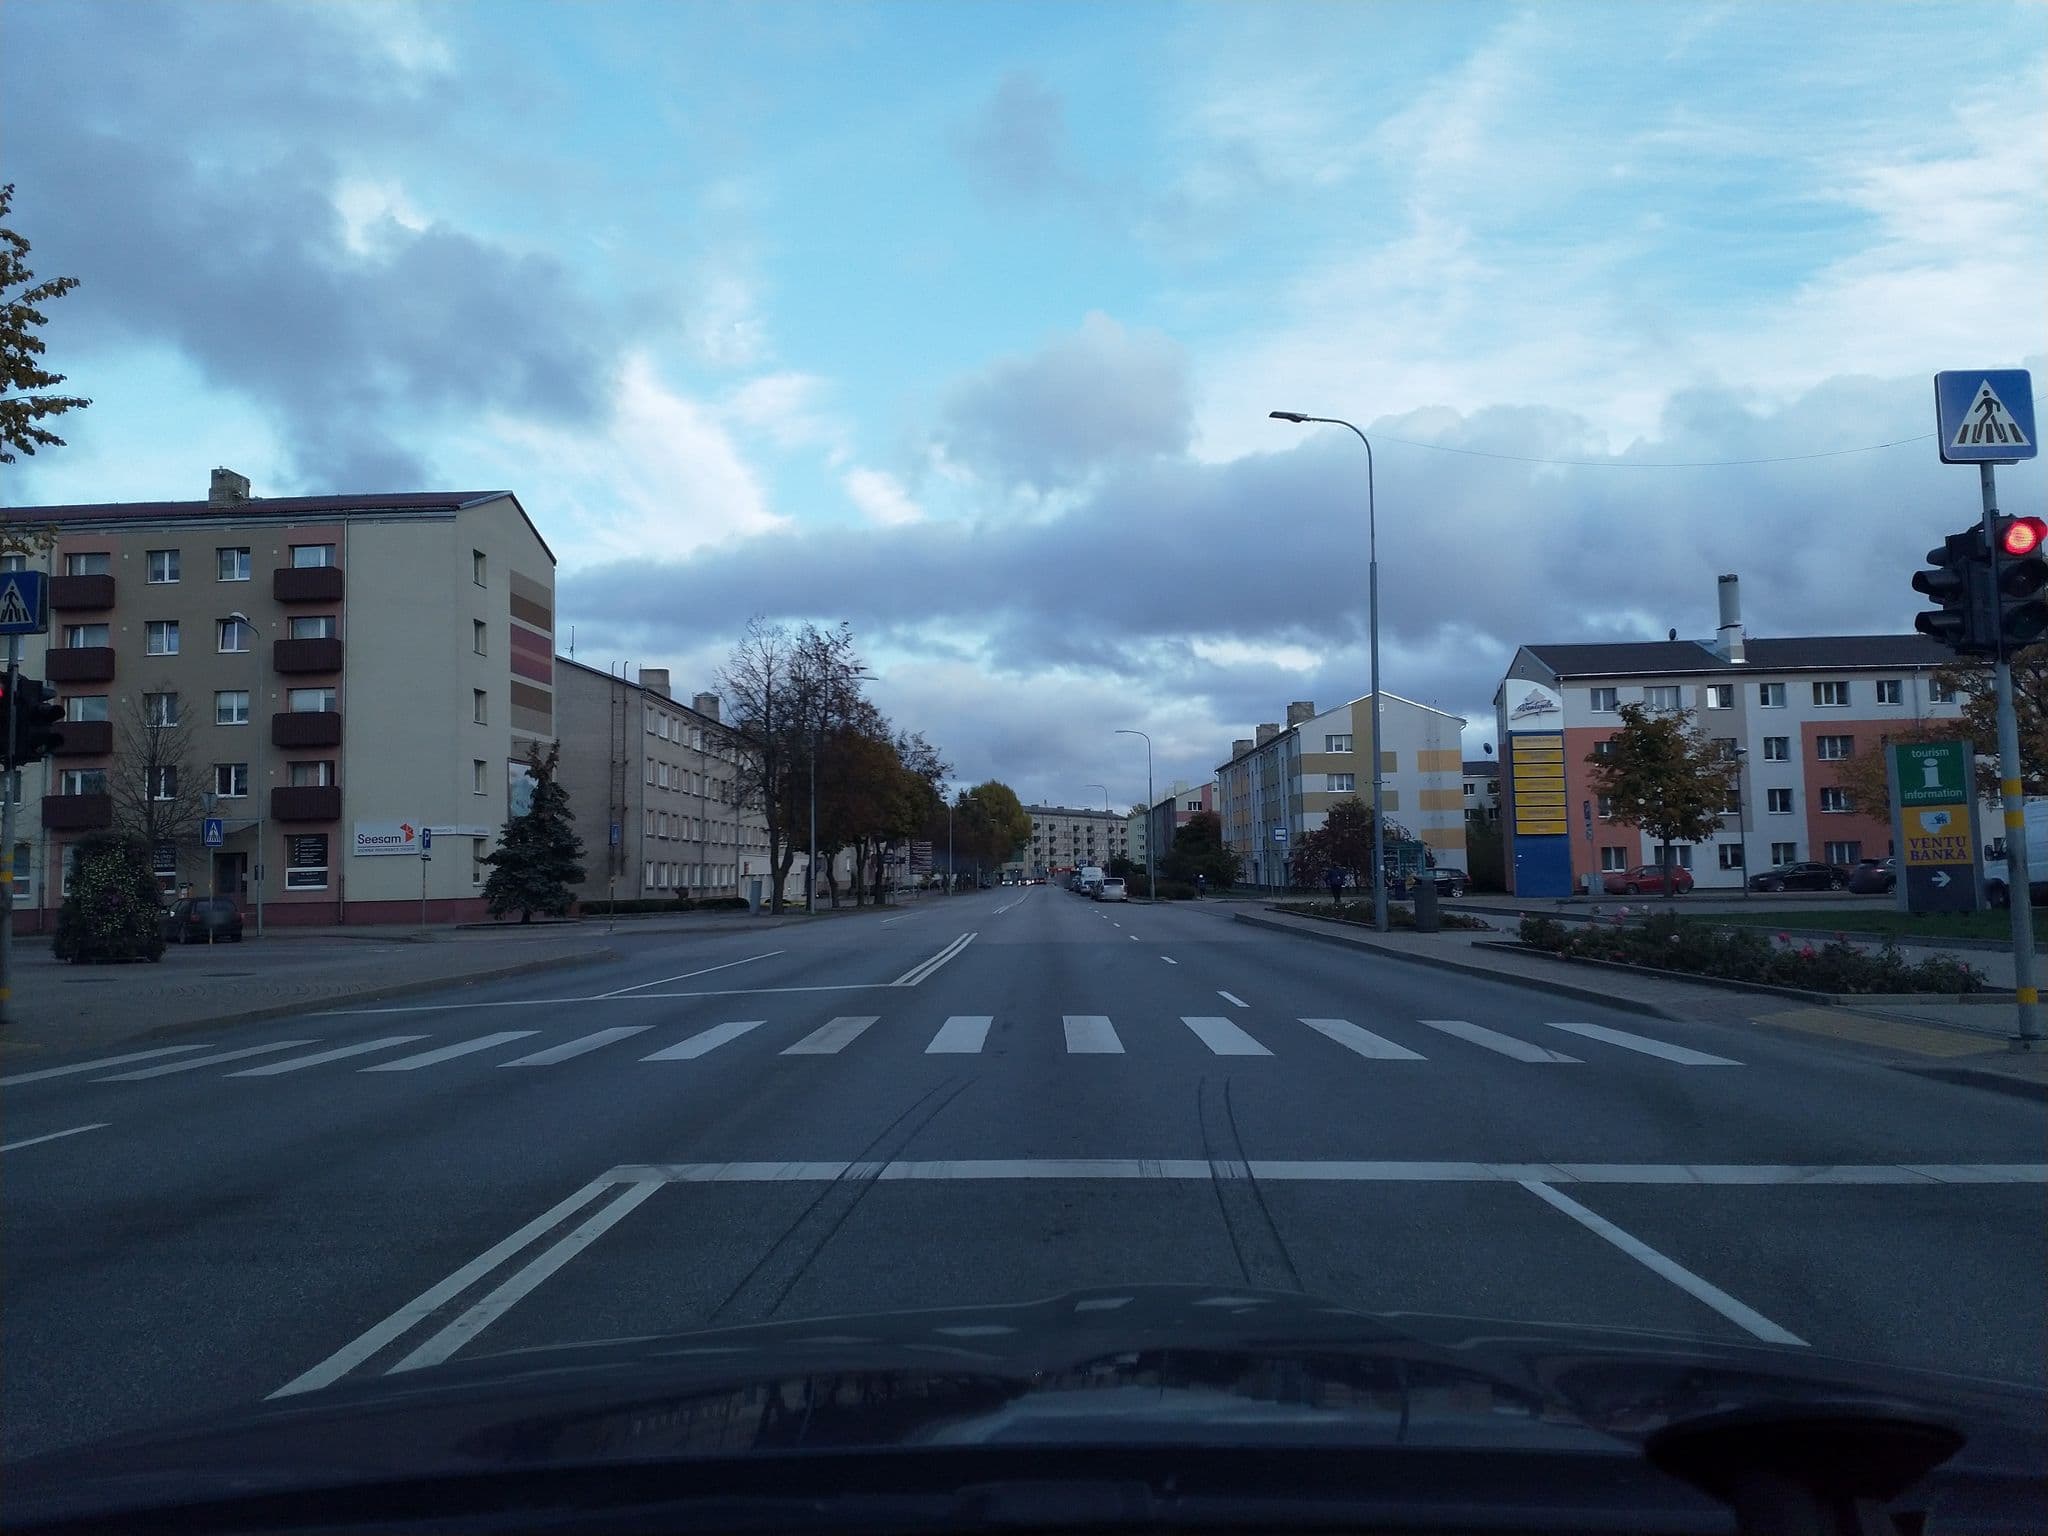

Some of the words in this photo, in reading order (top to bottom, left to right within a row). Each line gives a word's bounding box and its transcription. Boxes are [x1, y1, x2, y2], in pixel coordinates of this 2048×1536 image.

[1912, 748, 1949, 757] tourism
[1904, 789, 1962, 800] information
[358, 834, 401, 844] Seesam
[1910, 836, 1966, 849] VENTU
[1911, 848, 1967, 861] BANKA
